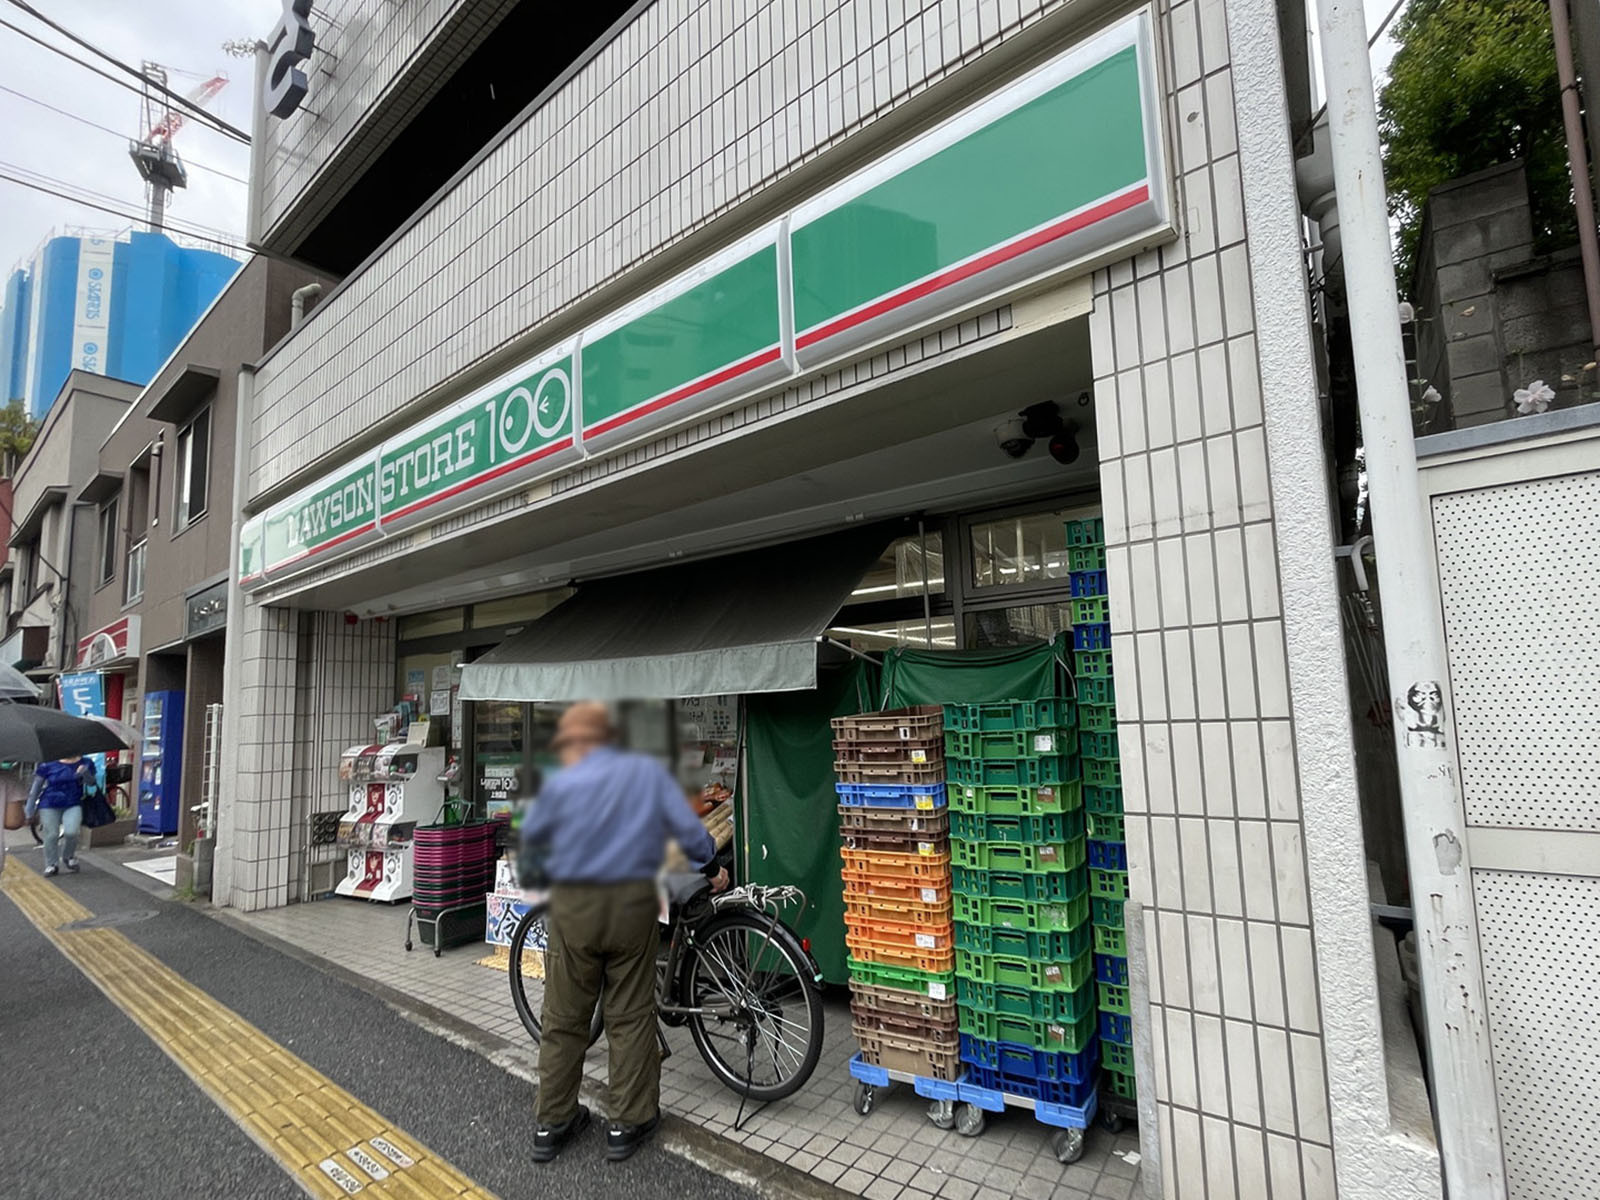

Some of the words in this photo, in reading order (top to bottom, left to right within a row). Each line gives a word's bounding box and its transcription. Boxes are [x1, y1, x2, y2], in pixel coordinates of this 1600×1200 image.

[288, 472, 374, 549] LAWSON
[381, 419, 476, 505] STORE
[485, 368, 571, 463] 100
